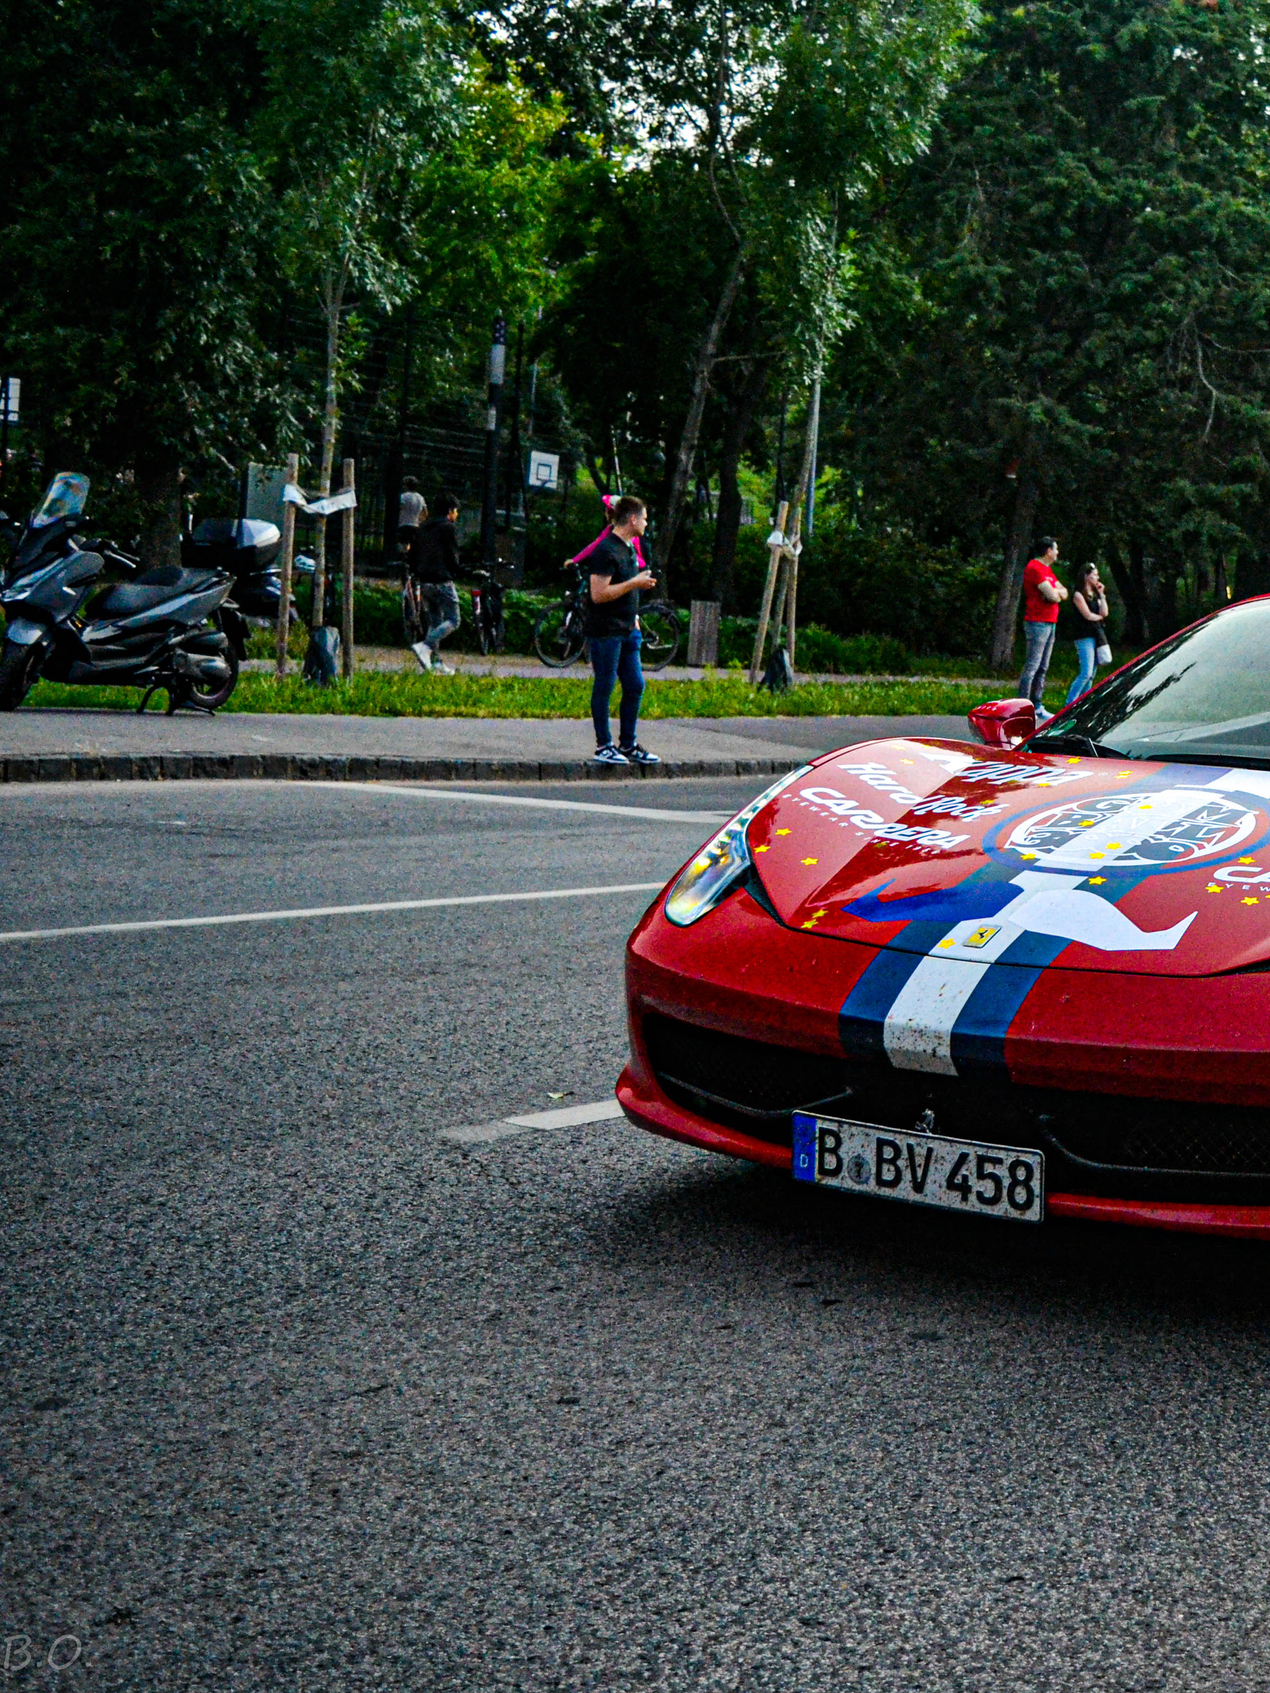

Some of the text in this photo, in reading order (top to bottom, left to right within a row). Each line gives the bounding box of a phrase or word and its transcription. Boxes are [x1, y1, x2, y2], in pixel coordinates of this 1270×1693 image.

[800, 787, 971, 849] CARRERA
[837, 762, 1010, 822] Hard Rock
[817, 1126, 1035, 1212] B BV 458
